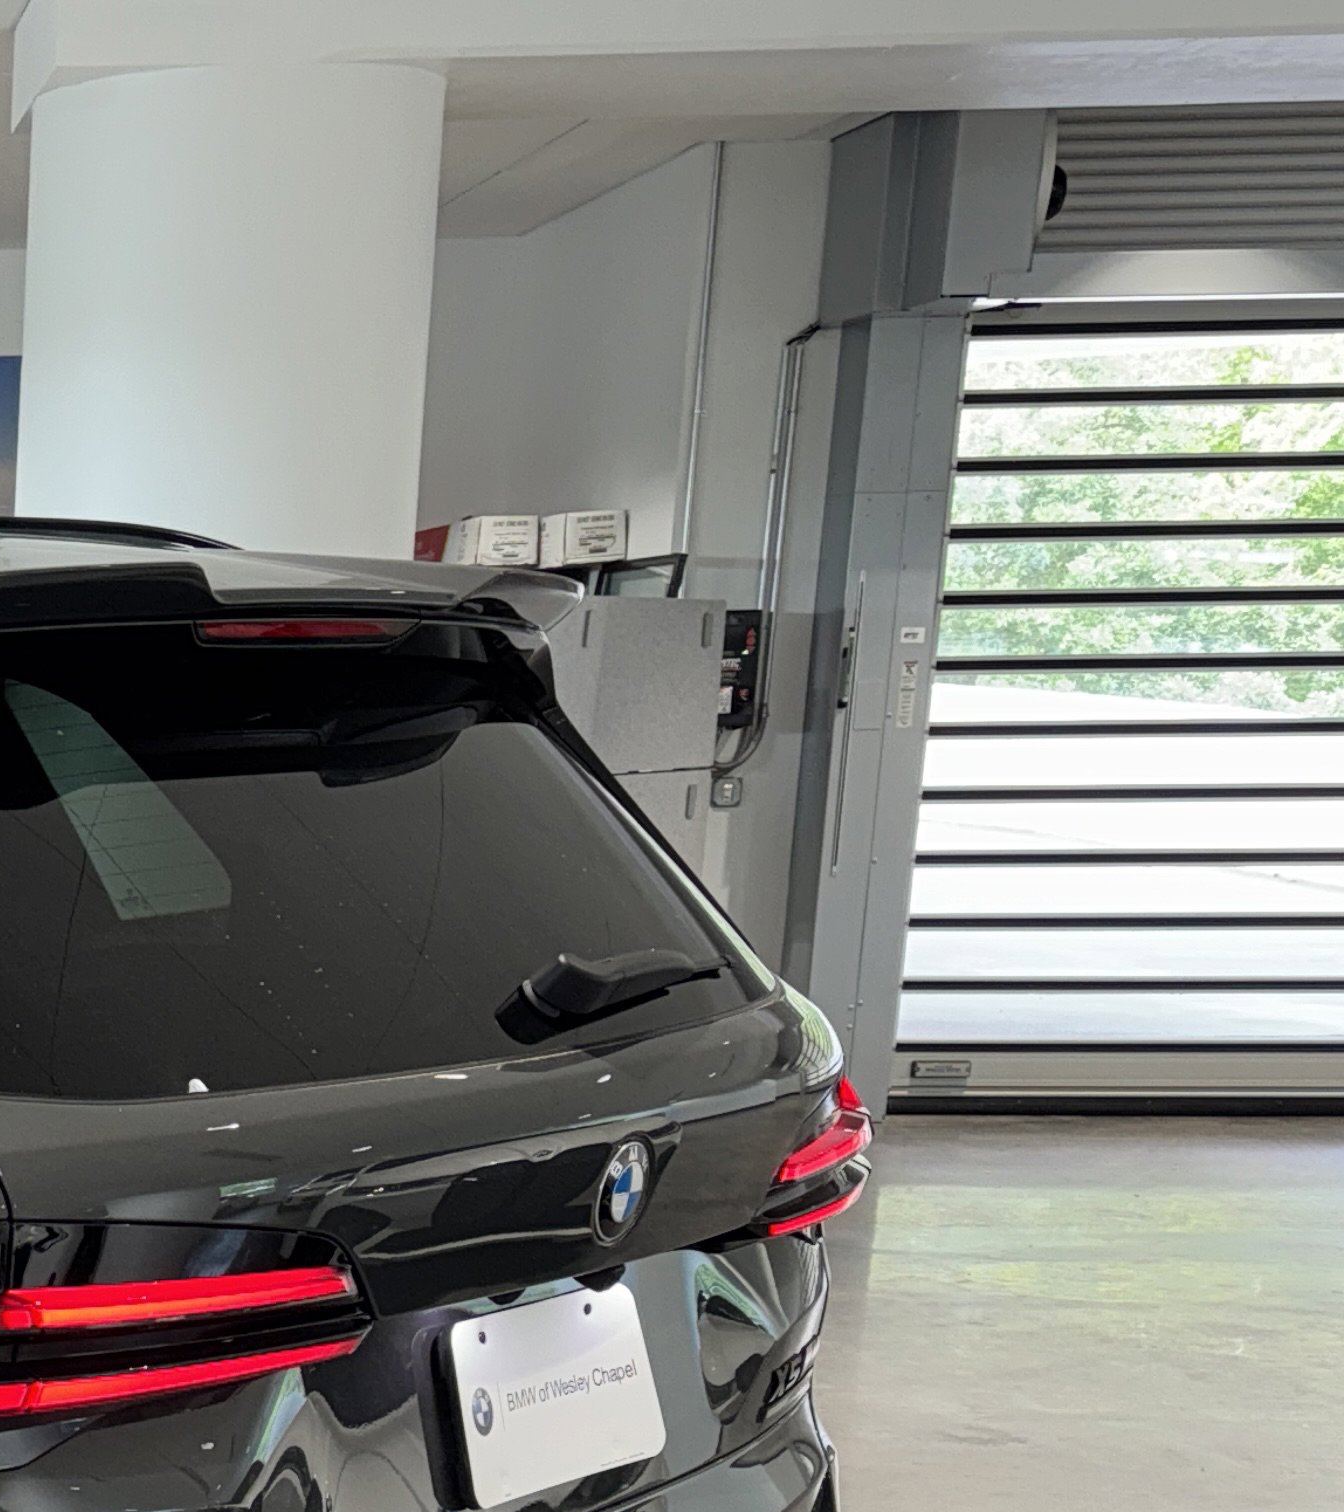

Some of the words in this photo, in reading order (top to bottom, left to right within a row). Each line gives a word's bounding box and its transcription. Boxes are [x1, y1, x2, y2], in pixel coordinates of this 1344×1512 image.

[506, 1386, 537, 1412] BMW
[538, 1381, 550, 1402] of
[551, 1375, 590, 1394] Wesley
[592, 1359, 638, 1387] Chapel
